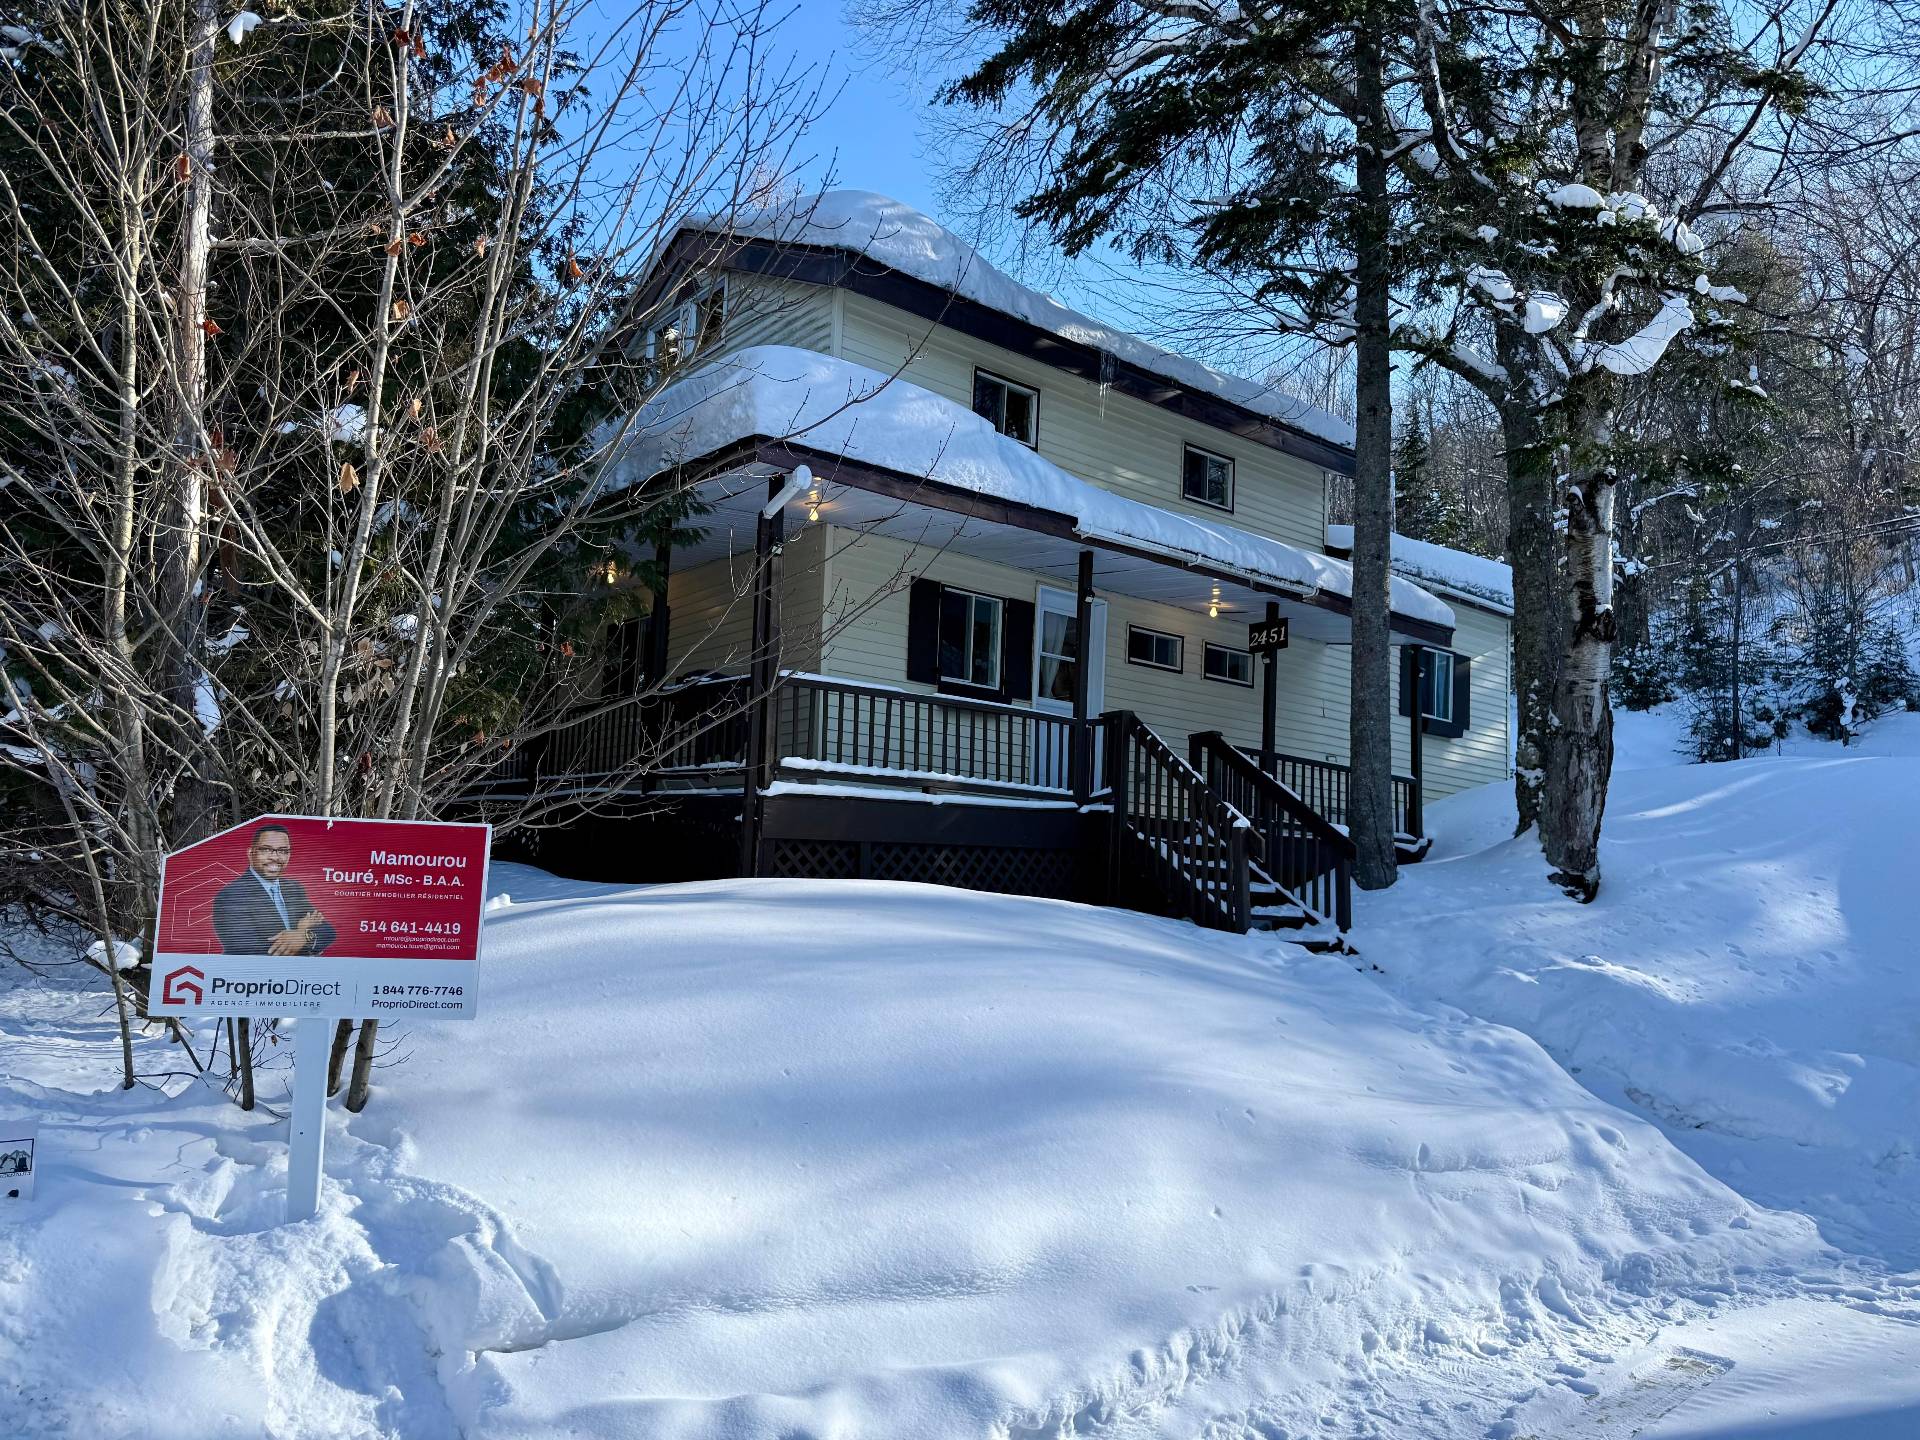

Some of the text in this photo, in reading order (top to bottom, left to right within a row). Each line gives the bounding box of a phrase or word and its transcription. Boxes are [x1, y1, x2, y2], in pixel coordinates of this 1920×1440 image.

[1250, 626, 1285, 647] 2451
[370, 850, 467, 868] Mamourou
[322, 867, 379, 886] Touré,
[384, 874, 413, 885] MSc
[423, 875, 465, 887] B.A.A.
[417, 892, 464, 900] RÉSIDENTIEL
[360, 920, 461, 934] 514 641-4419
[211, 977, 341, 997] ProprioDirect
[372, 985, 463, 996] 1 844 776-7746
[255, 1000, 321, 1008] IMMOBILIÈRE
[371, 999, 463, 1010] ProprioDirect.com
